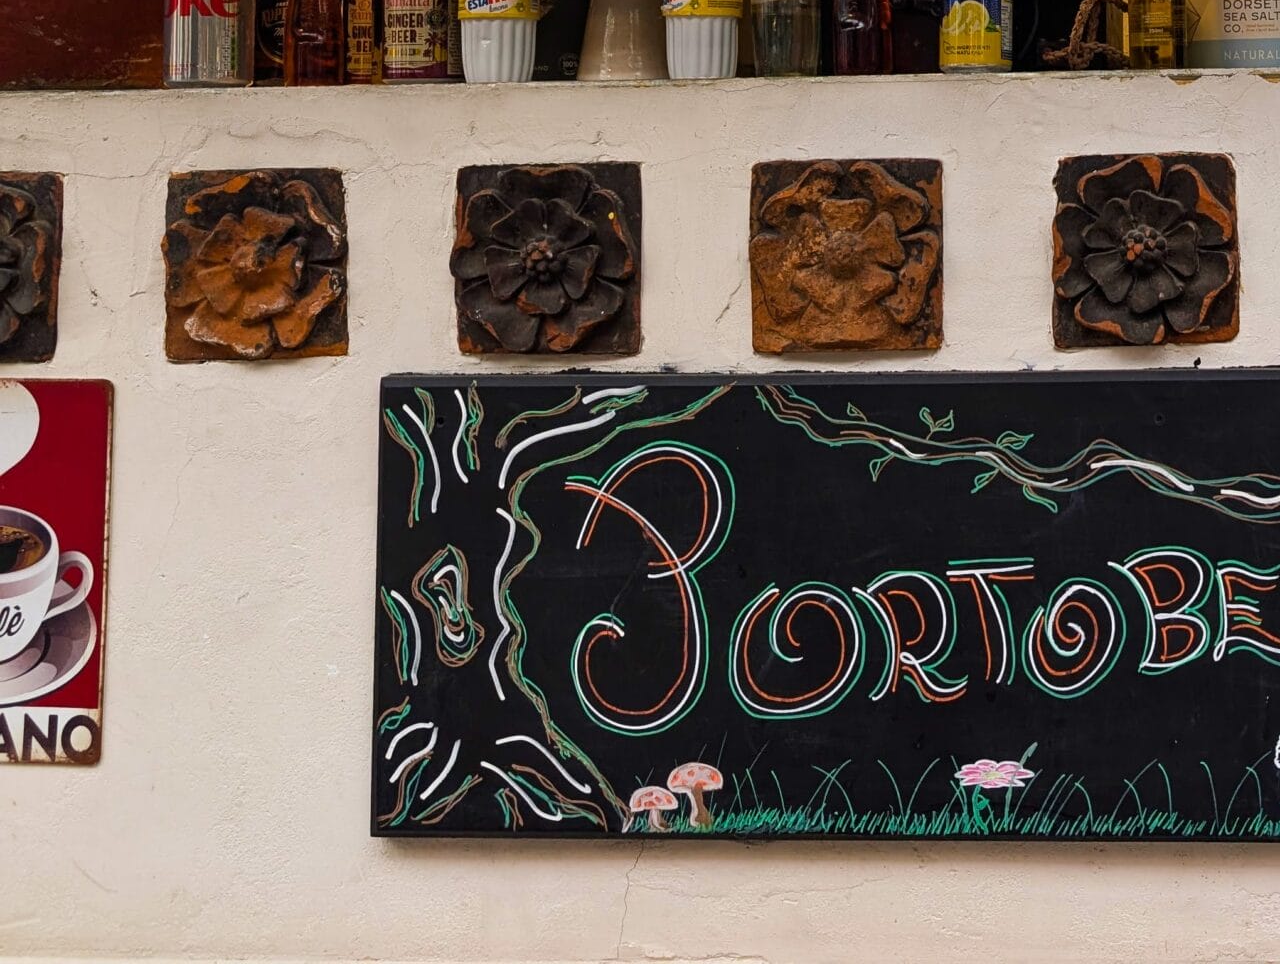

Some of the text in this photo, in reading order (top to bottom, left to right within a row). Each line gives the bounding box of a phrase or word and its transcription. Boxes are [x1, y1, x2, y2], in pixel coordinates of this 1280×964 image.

[387, 12, 424, 28] GINGER
[1223, 11, 1280, 22] SEA SALT
[1223, 24, 1244, 34] CO.
[391, 29, 417, 44] BEER
[1223, 50, 1280, 61] NATURAL
